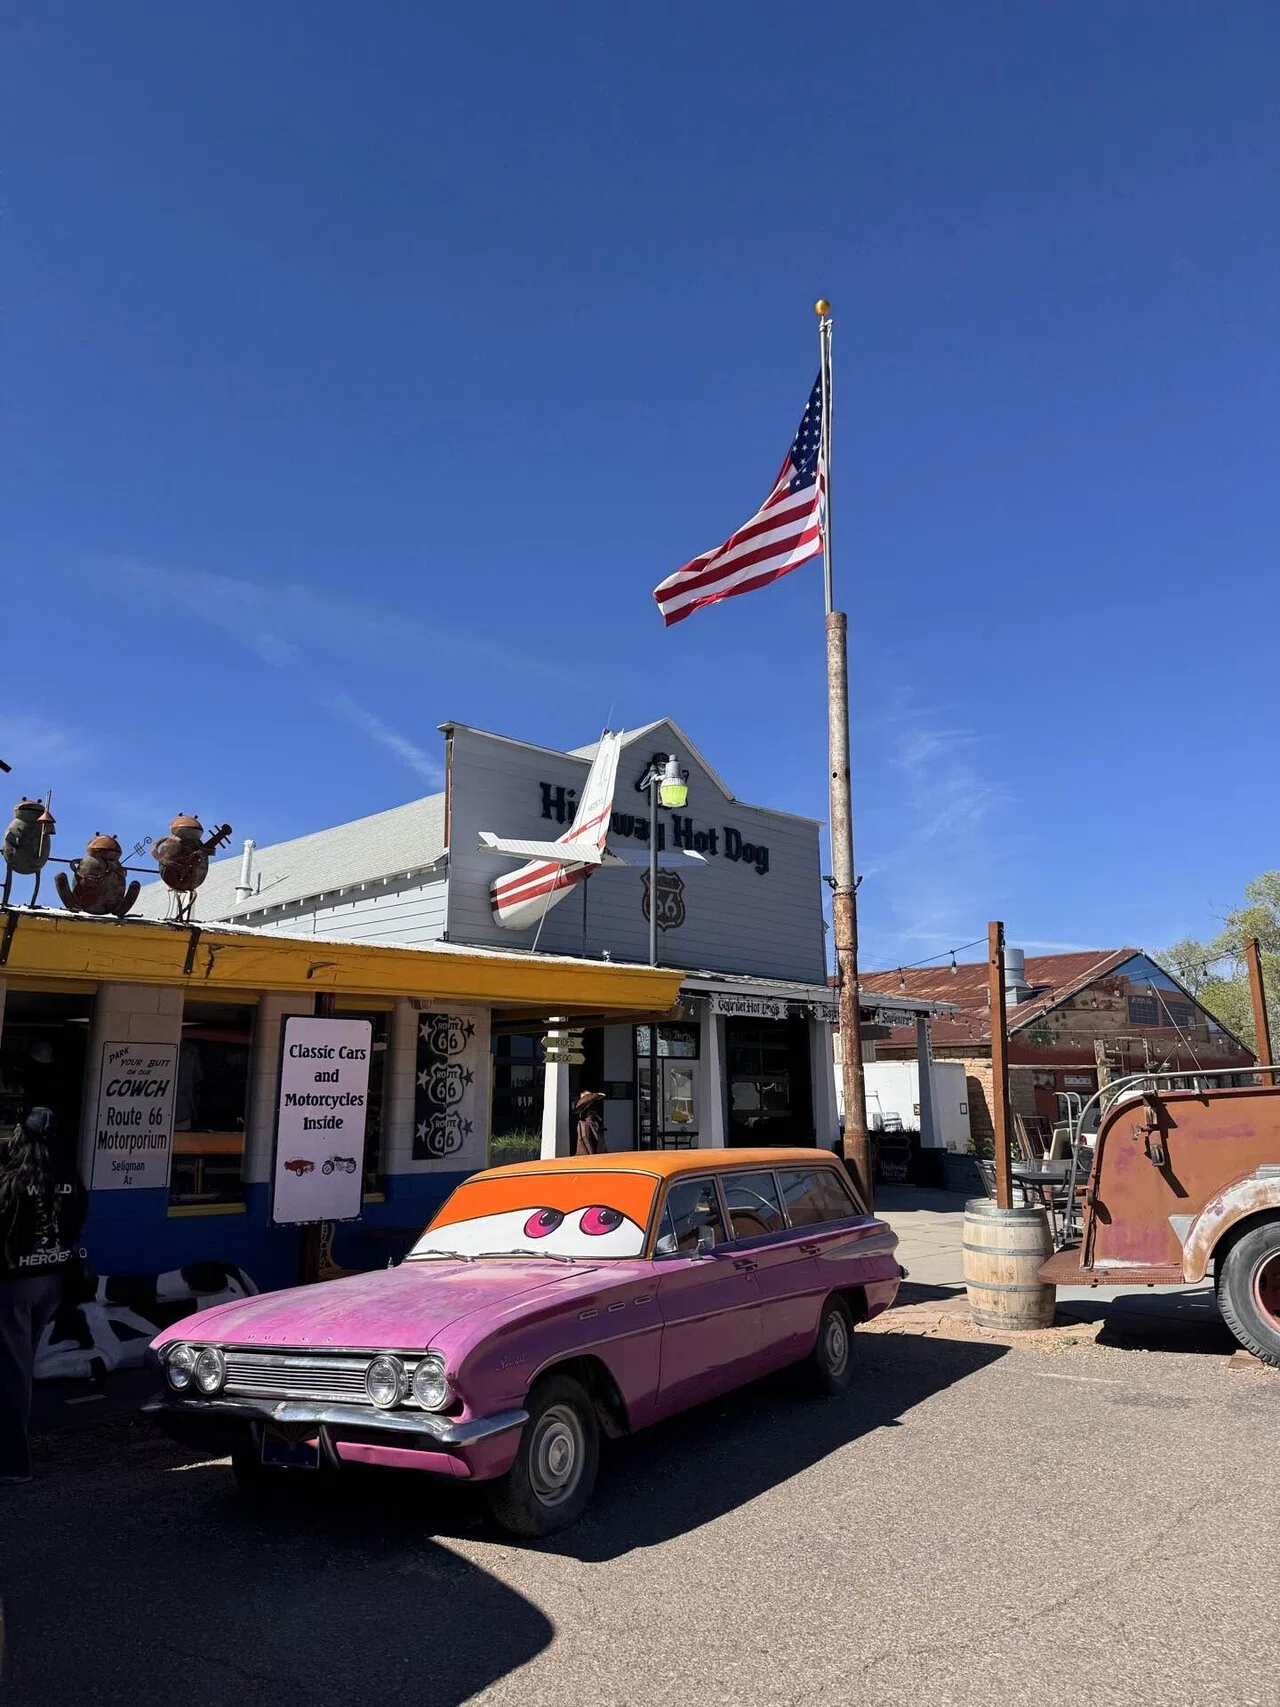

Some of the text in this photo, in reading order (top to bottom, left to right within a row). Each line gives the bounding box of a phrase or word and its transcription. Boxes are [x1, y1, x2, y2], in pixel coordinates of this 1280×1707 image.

[539, 781, 769, 876] Hiway Hot Dog
[745, 1000, 760, 1014] Hot
[438, 1022, 460, 1030] ROUTE
[438, 1032, 458, 1050] 66
[556, 1037, 575, 1047] RIDES
[109, 1047, 129, 1064] PARK
[289, 1044, 367, 1060] Classic Cars
[120, 1059, 171, 1068] YOUR BUTT
[313, 1069, 339, 1083] and
[436, 1071, 458, 1079] ROUTE
[106, 1078, 170, 1097] COWCH
[436, 1081, 456, 1099] 66
[285, 1093, 364, 1110] Motorcycles
[107, 1106, 163, 1126] Route 66
[303, 1115, 344, 1130] Inside
[435, 1119, 457, 1128] ROUTE
[97, 1130, 167, 1155] Motorporium
[434, 1130, 454, 1149] 66
[111, 1160, 145, 1173] Seligman
[123, 1174, 133, 1185] Az
